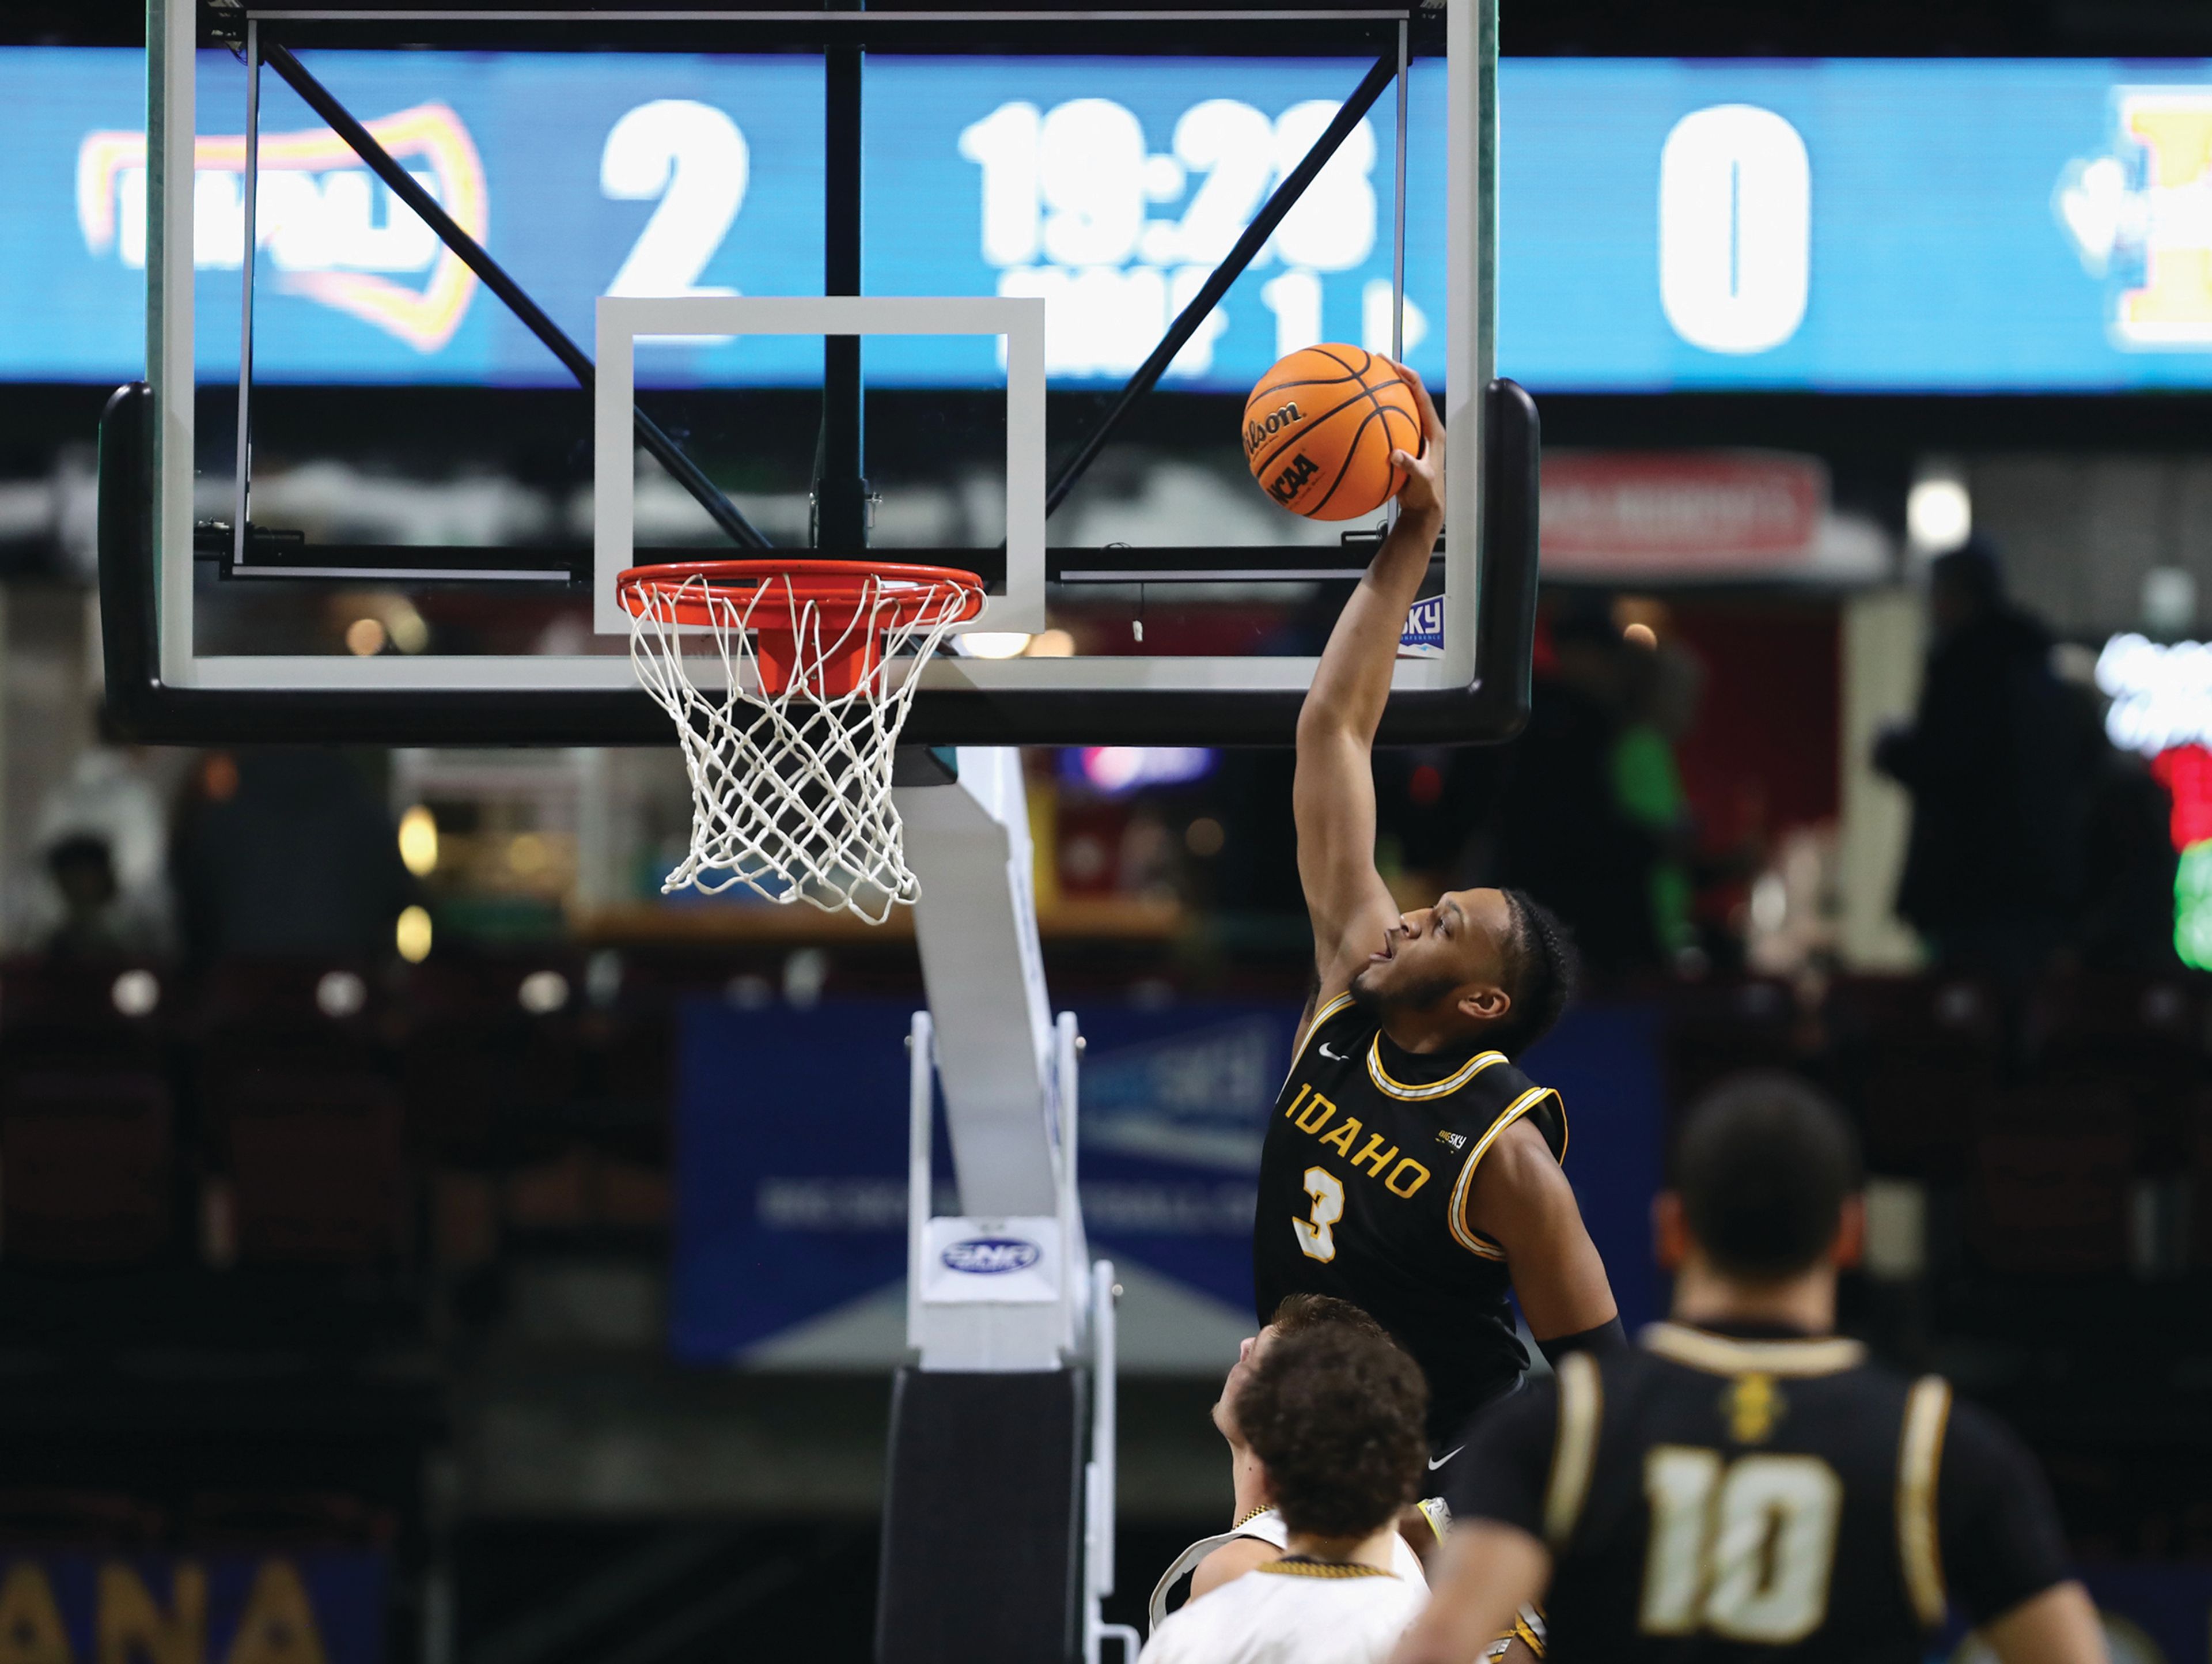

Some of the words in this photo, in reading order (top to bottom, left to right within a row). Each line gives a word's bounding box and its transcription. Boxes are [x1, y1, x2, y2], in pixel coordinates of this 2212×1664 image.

[600, 99, 750, 346] 2
[1658, 103, 1810, 354] 0
[1267, 453, 1319, 505] NCAA
[1285, 1082, 1431, 1199] IDAHO
[1291, 1165, 1346, 1264] 3
[1637, 1443, 1843, 1645] 10
